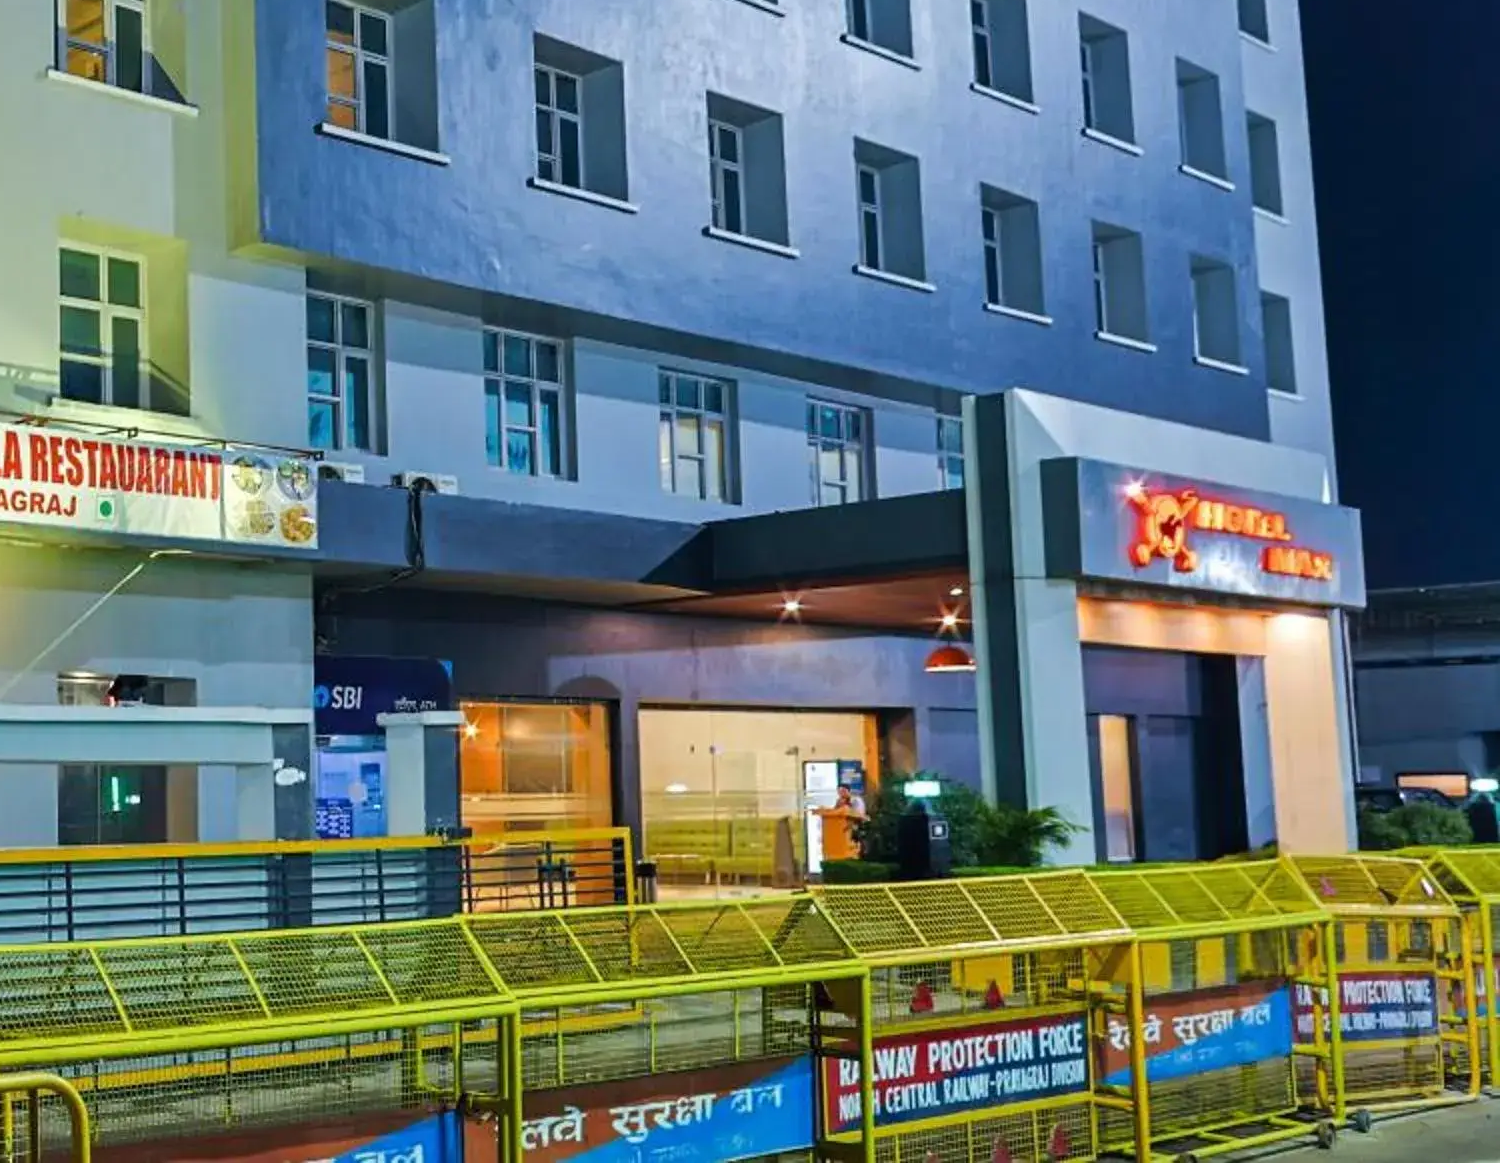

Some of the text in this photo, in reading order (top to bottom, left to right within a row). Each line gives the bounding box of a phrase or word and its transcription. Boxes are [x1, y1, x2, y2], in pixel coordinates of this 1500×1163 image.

[1196, 499, 1292, 541] HOTEL
[331, 685, 363, 710] SBI
[1171, 1008, 1235, 1046] सुरक्षा
[839, 1022, 1083, 1087] RALWAY PROTECTION FORCE
[885, 1080, 941, 1115] CENTRAL
[609, 1092, 718, 1144] सुरक्षा
